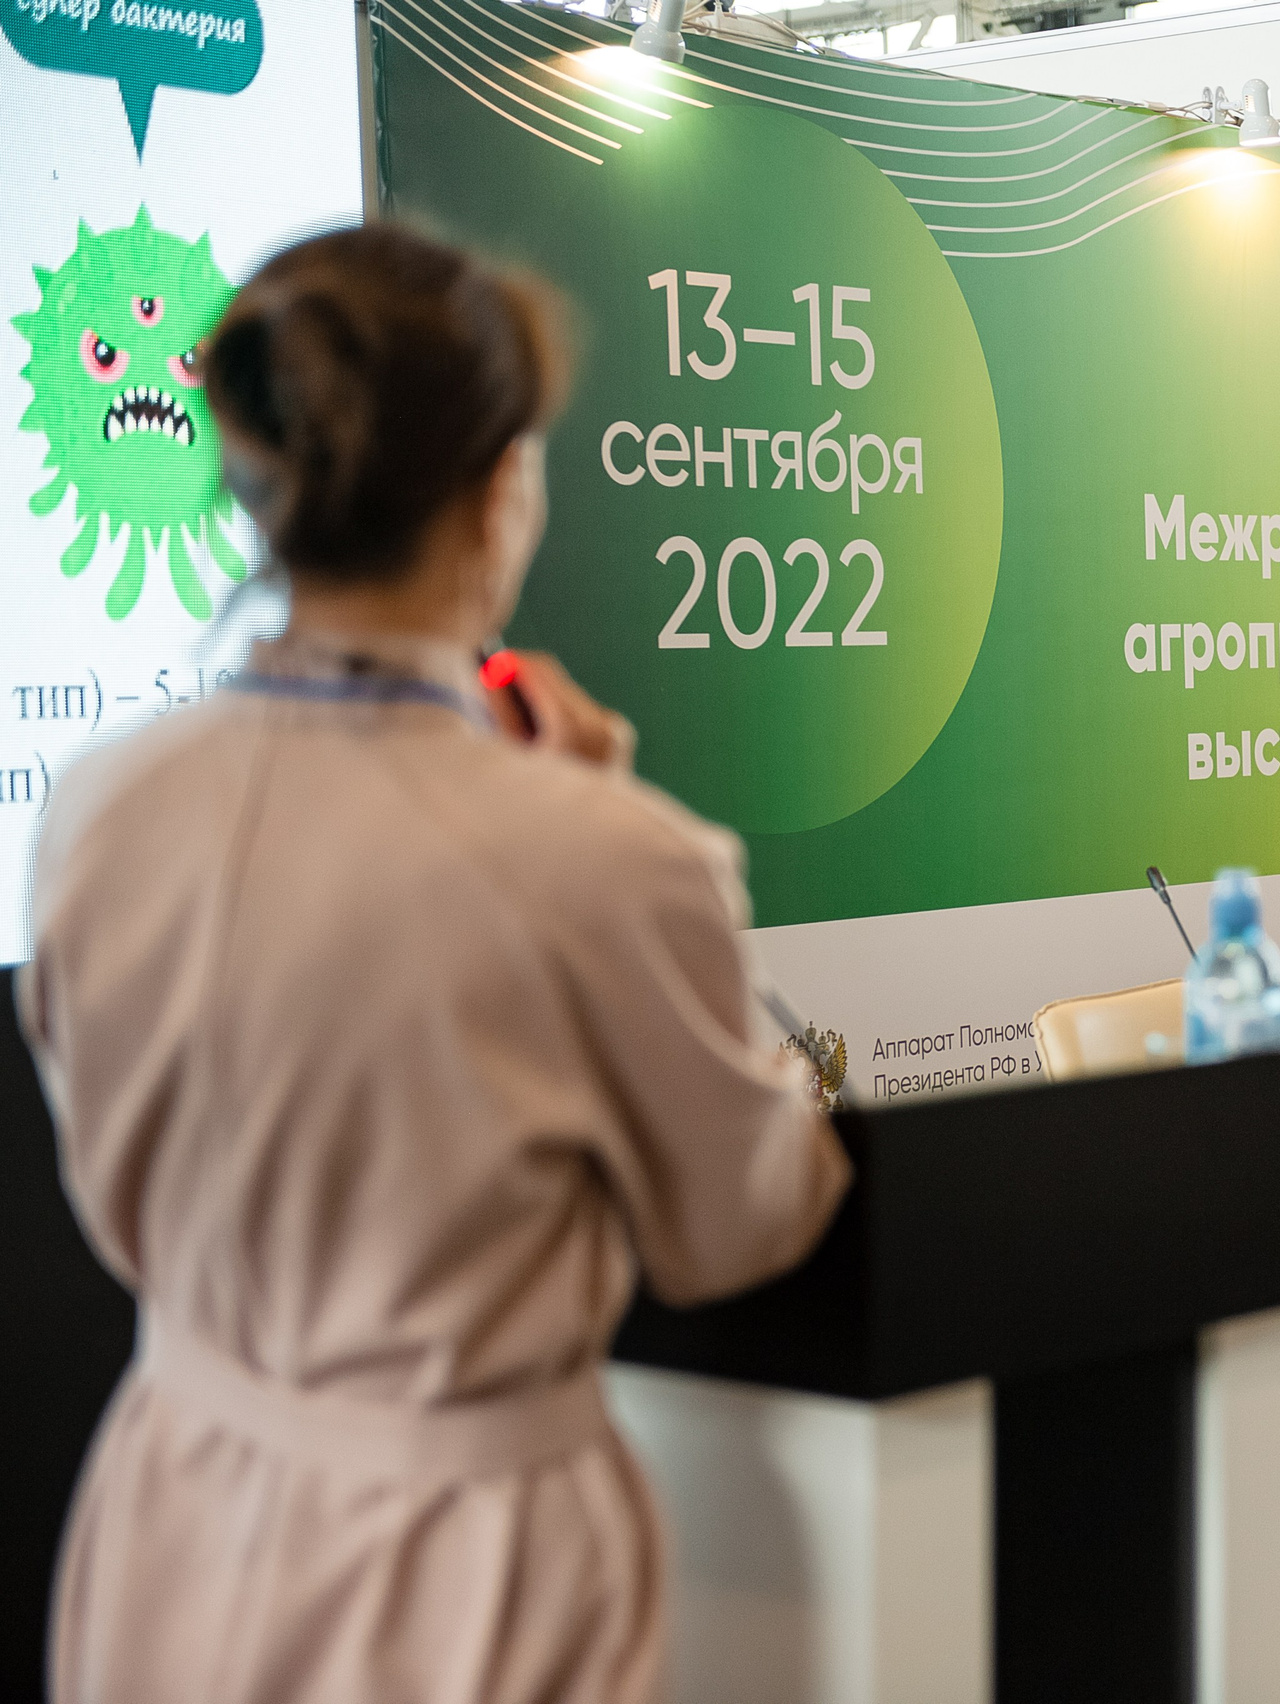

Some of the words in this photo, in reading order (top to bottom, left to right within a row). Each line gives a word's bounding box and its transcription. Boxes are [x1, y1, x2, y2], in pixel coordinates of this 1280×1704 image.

[601, 409, 924, 515] сентября
[655, 535, 888, 650] 2022
[872, 1033, 955, 1062] Аппарат
[874, 1064, 985, 1102] Президента
[990, 1054, 1017, 1079] РФ
[1021, 1057, 1031, 1074] в
